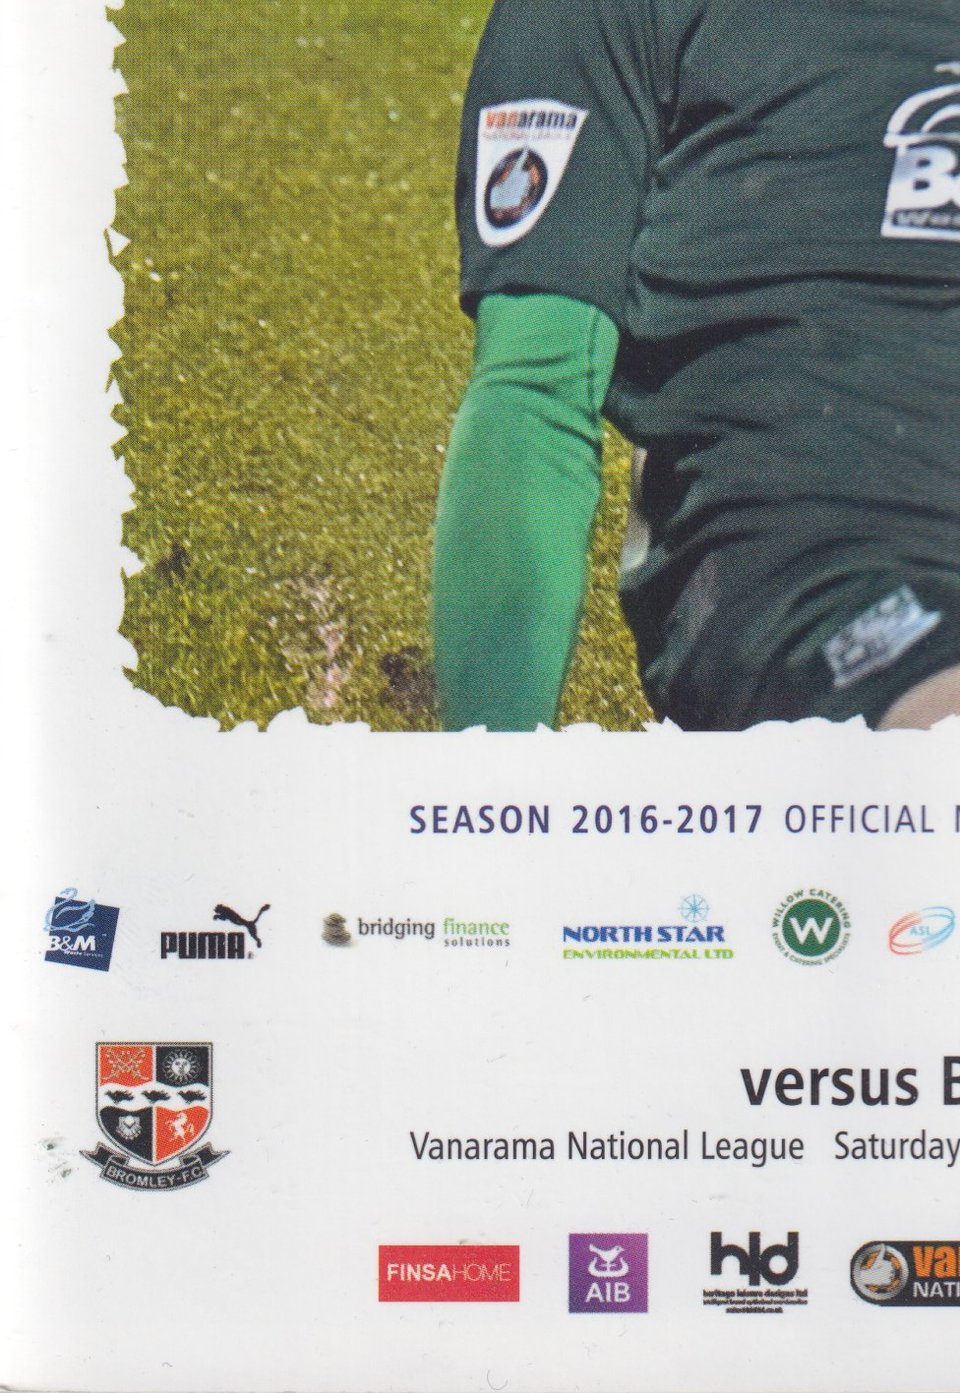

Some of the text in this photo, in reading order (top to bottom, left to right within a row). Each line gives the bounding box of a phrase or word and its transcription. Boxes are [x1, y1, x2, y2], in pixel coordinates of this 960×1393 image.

[486, 111, 578, 129] vanarama
[410, 805, 549, 834] SEASON
[573, 805, 761, 833] 2016-2017
[785, 805, 934, 833] OFFICIAL
[772, 888, 852, 929] WILLOW CATERING
[358, 917, 509, 939] bridging finance
[563, 926, 725, 943] NORTH STAR
[788, 917, 834, 945] W
[910, 925, 931, 937] ASL
[49, 935, 96, 951] B&M
[161, 932, 245, 959] PUMA
[444, 937, 510, 947] solutions
[563, 948, 734, 959] ENVIRONMENTAL LTD
[740, 1068, 918, 1106] versus
[410, 1132, 554, 1160] Vanarama
[569, 1129, 687, 1160] National
[702, 1132, 804, 1167] League
[835, 1129, 960, 1167] Saturday
[387, 1263, 512, 1282] FINSAHOME
[585, 1282, 631, 1303] AIB
